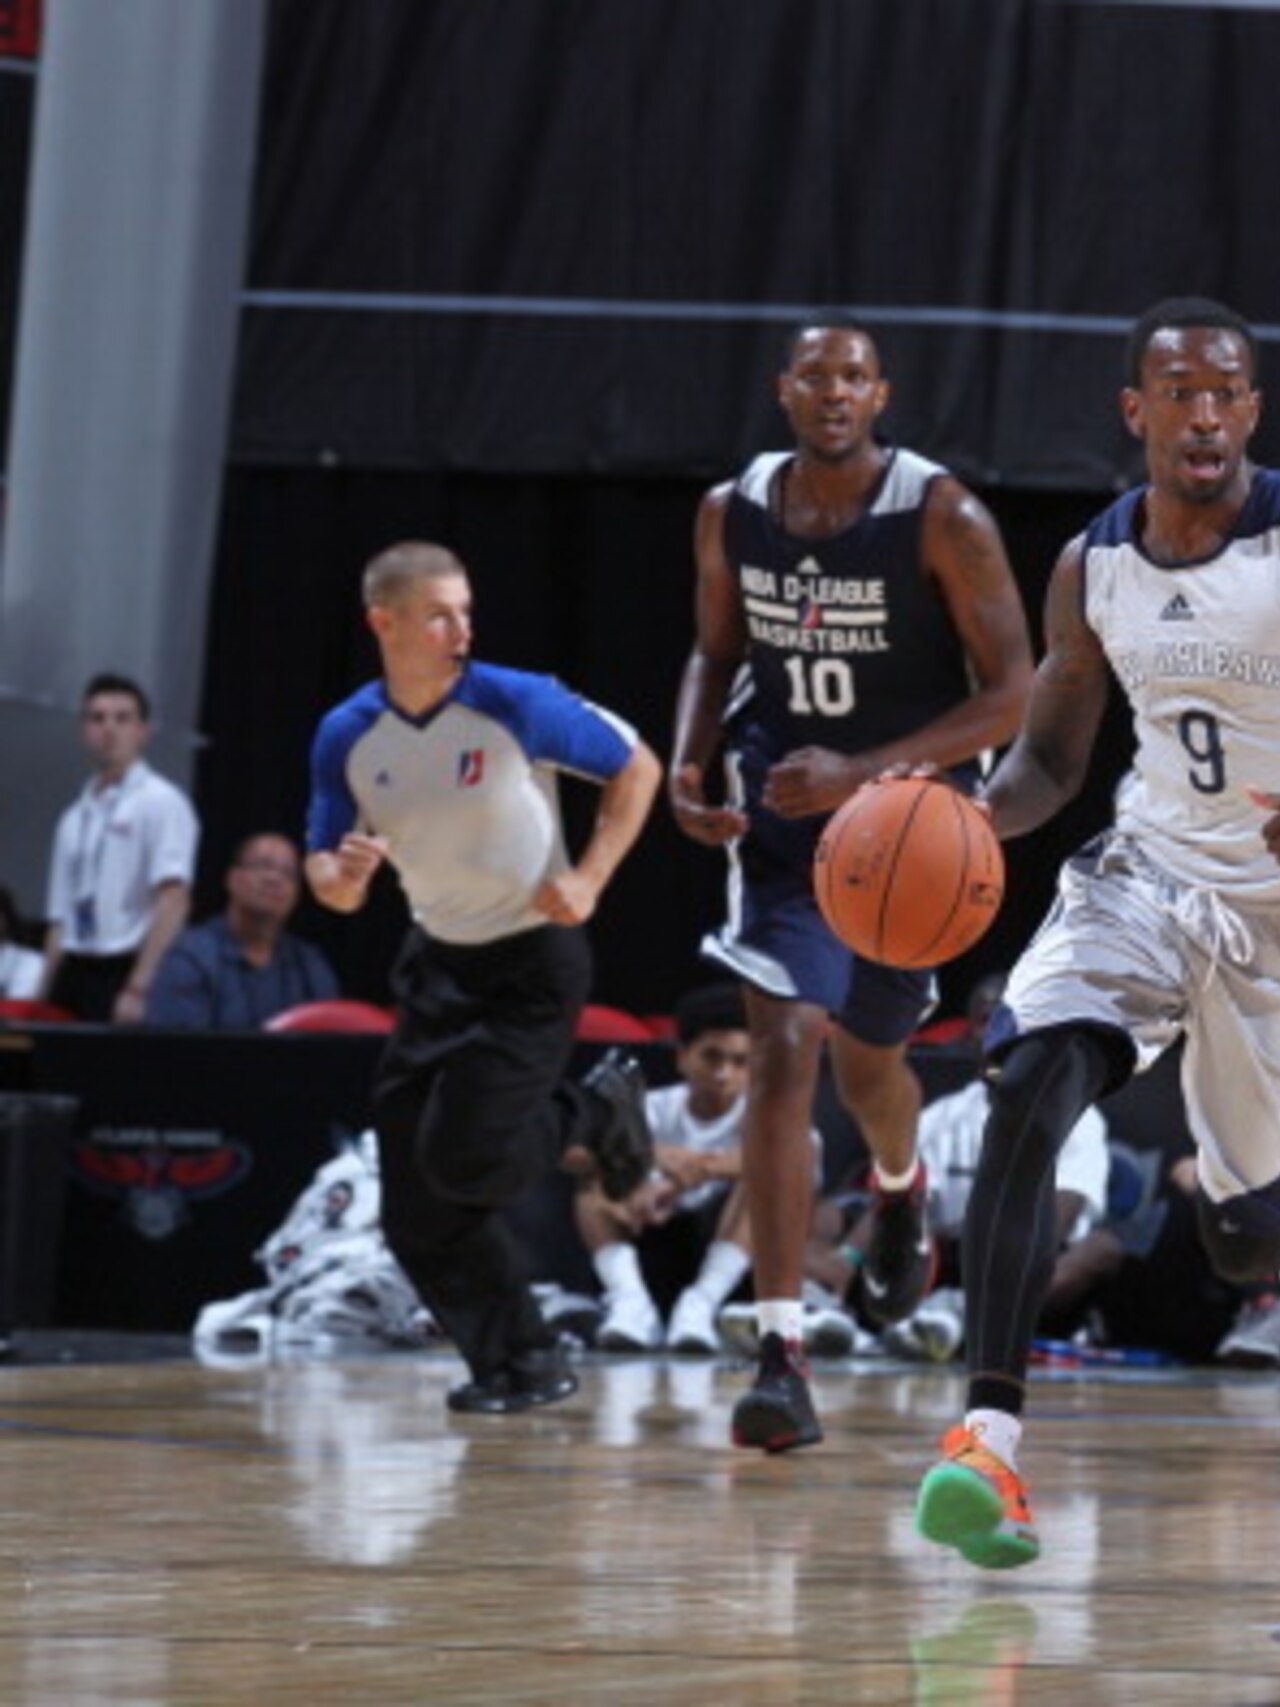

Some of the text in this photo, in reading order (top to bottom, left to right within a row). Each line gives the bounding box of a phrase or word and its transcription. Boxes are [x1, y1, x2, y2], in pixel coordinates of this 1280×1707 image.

[783, 575, 885, 604] D-LEAGUE
[748, 616, 890, 652] BASKETBALL
[785, 655, 855, 716] 10
[1178, 709, 1225, 794] 9
